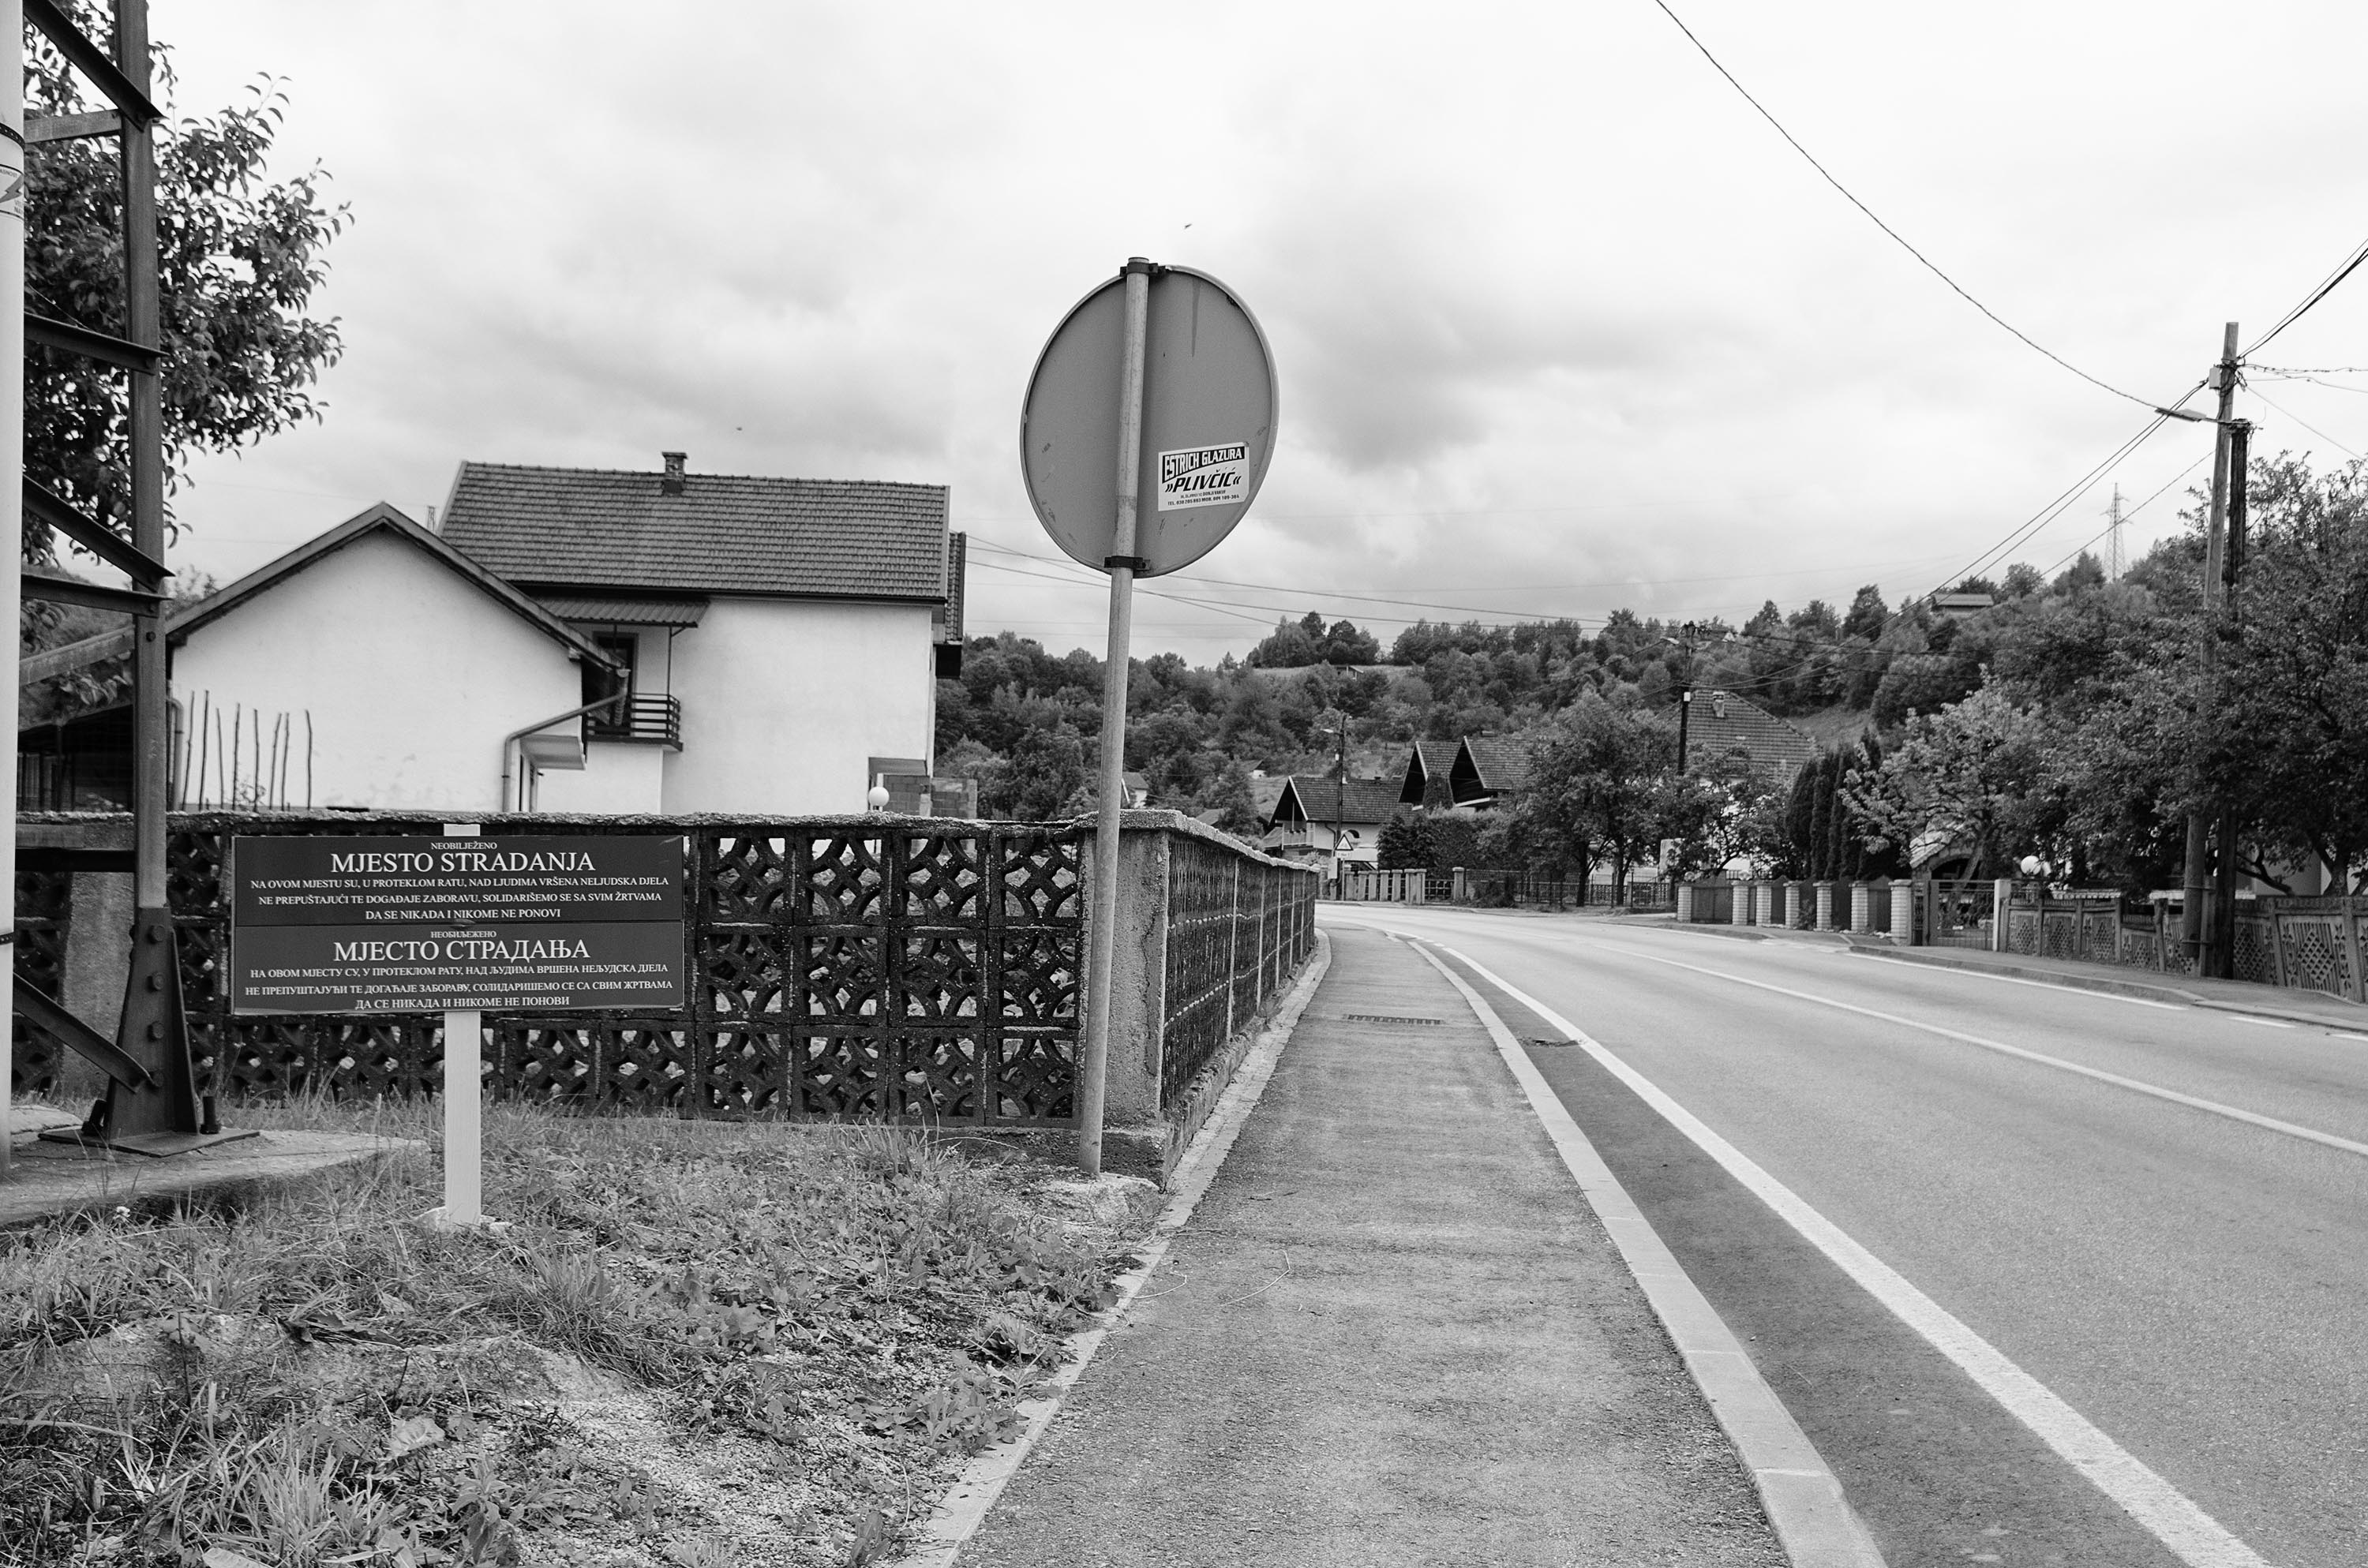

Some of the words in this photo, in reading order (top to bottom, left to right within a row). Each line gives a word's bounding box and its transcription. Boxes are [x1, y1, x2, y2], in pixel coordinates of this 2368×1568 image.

[1164, 452, 1200, 481] ESTRICH
[1201, 448, 1242, 466] GLAZURA
[430, 840, 498, 850] NEOBILJEŽENO
[331, 852, 433, 873] MJESTO
[440, 851, 596, 872] STRADANJA
[250, 880, 267, 889] NA
[267, 880, 301, 889] OVOM
[302, 879, 343, 889] MJESTU
[344, 879, 361, 889] SU,
[362, 879, 371, 888] U
[373, 878, 436, 888] PROTEKLOM
[437, 878, 467, 887] RATU,
[468, 878, 492, 887] NAD
[493, 878, 538, 887] LJUDIMA
[538, 877, 579, 886] VRŠENA
[579, 877, 638, 886] NELJUDSKA
[639, 877, 669, 885] DJELA
[258, 896, 274, 905] NE
[275, 893, 349, 905] PREPUŠTAJUĆI
[350, 895, 364, 904] TE
[365, 895, 422, 904] DOGAĐAJE
[422, 894, 481, 904] ZABORAVU,
[482, 893, 558, 903] SOLIDARIŠEMO
[559, 893, 572, 902] SE
[573, 893, 587, 902] SA
[587, 893, 613, 901] SVIM
[615, 892, 662, 901] ŽRTVAMA
[365, 911, 383, 920] DA
[384, 910, 399, 920] SE
[399, 910, 445, 919] NIKADA
[447, 910, 451, 919] I
[453, 909, 499, 919] NIKOME
[500, 909, 517, 918] NE
[519, 908, 560, 918] PONOVI
[333, 941, 440, 962] МЈЕСТО
[446, 939, 591, 963] СТРАДАЊА
[250, 969, 267, 979] НА
[268, 969, 300, 978] ОВОМ
[302, 968, 343, 977] МЈЕСТУ
[344, 967, 361, 977] СУ,
[362, 967, 371, 977] У
[372, 967, 436, 976] ПРОТЕКЛОМ
[438, 966, 464, 975] РАТУ,
[466, 966, 489, 975] НАД
[489, 965, 535, 975] ЉУДИМА
[537, 965, 580, 974] ВРШЕНА
[582, 964, 637, 974] НЕЉУДСКА
[637, 964, 669, 974] ДЈЕЛА
[245, 986, 260, 996] НЕ
[261, 985, 348, 995] ПРЕПУШТАЈУЋИ
[349, 985, 363, 994] ТЕ
[364, 984, 418, 995] ДОГАЂАЈЕ
[419, 983, 471, 993] ЗАБОРАВУ,
[472, 982, 560, 993] СОЛИДАРИШЕМО
[561, 982, 575, 990] СЕ
[576, 982, 590, 990] СА
[592, 981, 622, 990] СВИМ
[623, 980, 673, 990] ЖРТВАМА
[354, 999, 373, 1010] ДА
[373, 999, 390, 1009] СЕ
[392, 998, 440, 1009] НИКАДА
[442, 998, 451, 1008] И
[453, 997, 503, 1007] НИКОМЕ
[504, 997, 520, 1006] НЕ
[522, 996, 570, 1006] ПОНОВИ
